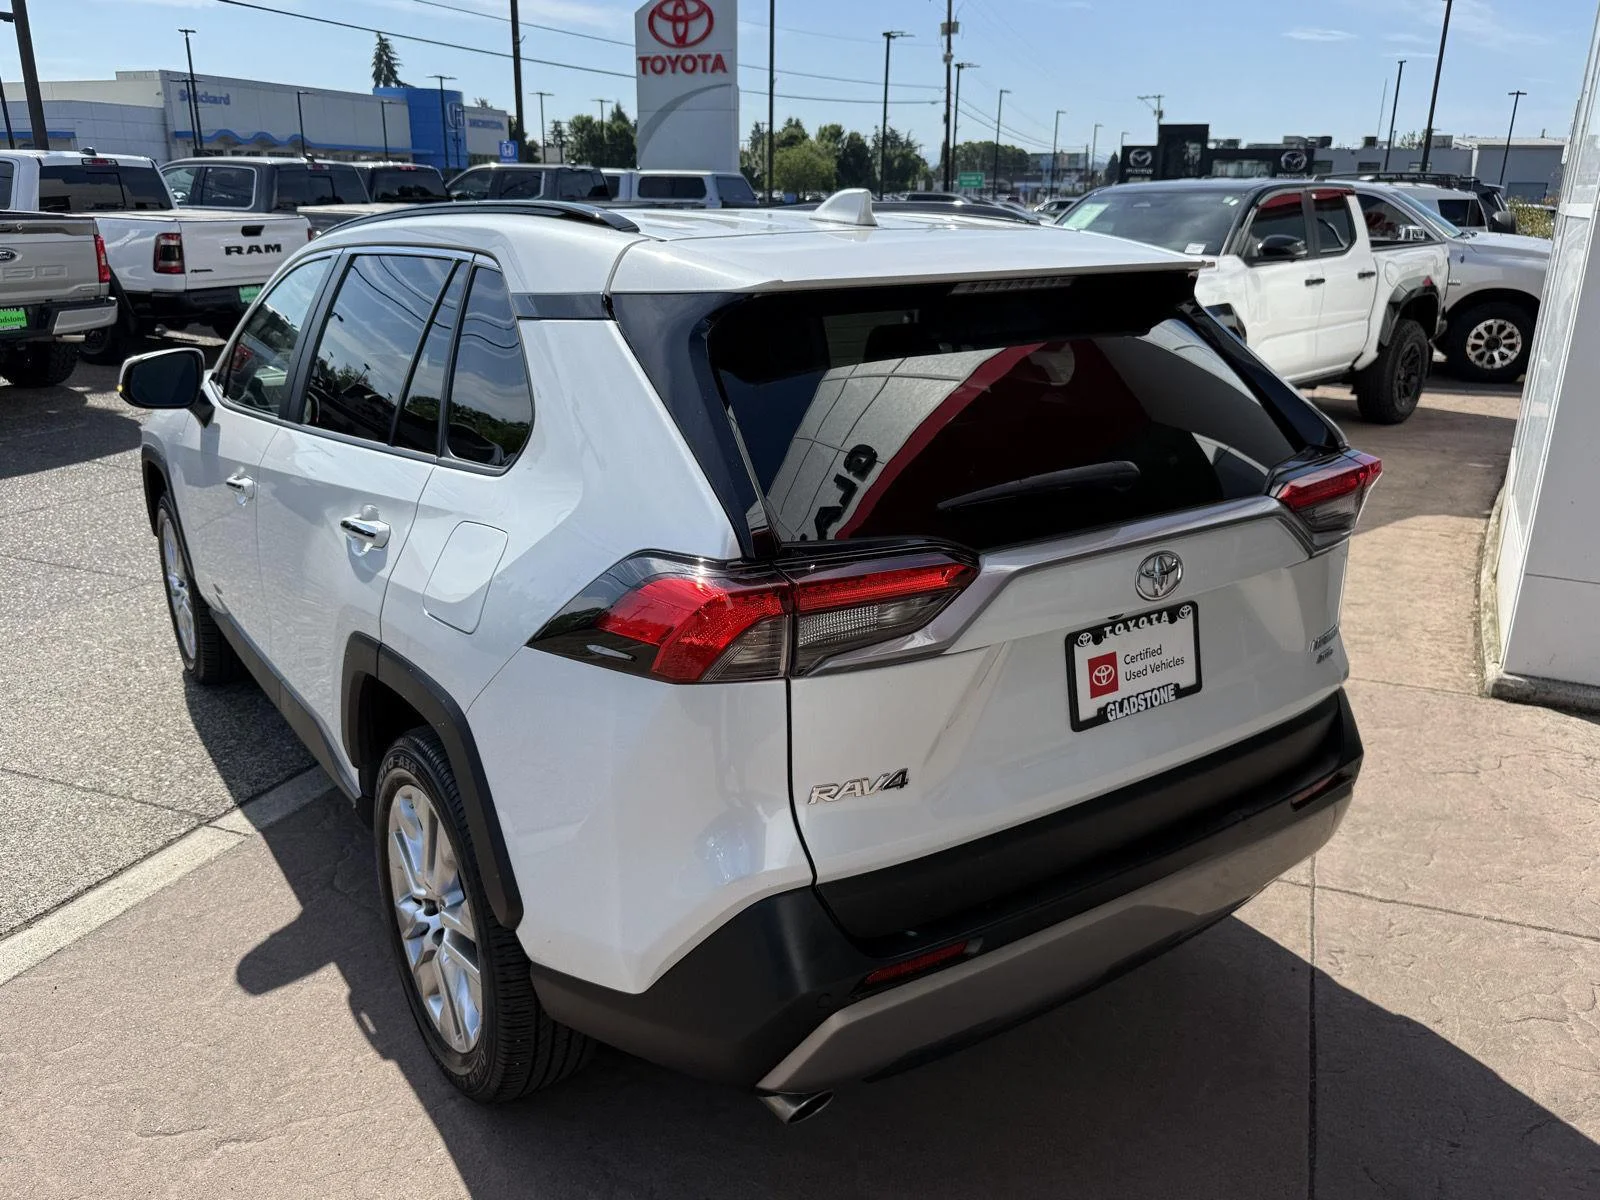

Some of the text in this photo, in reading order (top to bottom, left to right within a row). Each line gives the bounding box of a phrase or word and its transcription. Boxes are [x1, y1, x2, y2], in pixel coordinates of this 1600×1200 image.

[637, 53, 728, 75] TOYOTA
[224, 243, 282, 256] RAM
[1102, 611, 1169, 638] TOYOTA
[1123, 644, 1163, 665] Certified
[1125, 656, 1185, 682] Used Vehicles
[1106, 683, 1176, 721] GLADSTONE
[808, 767, 909, 805] RAV4
